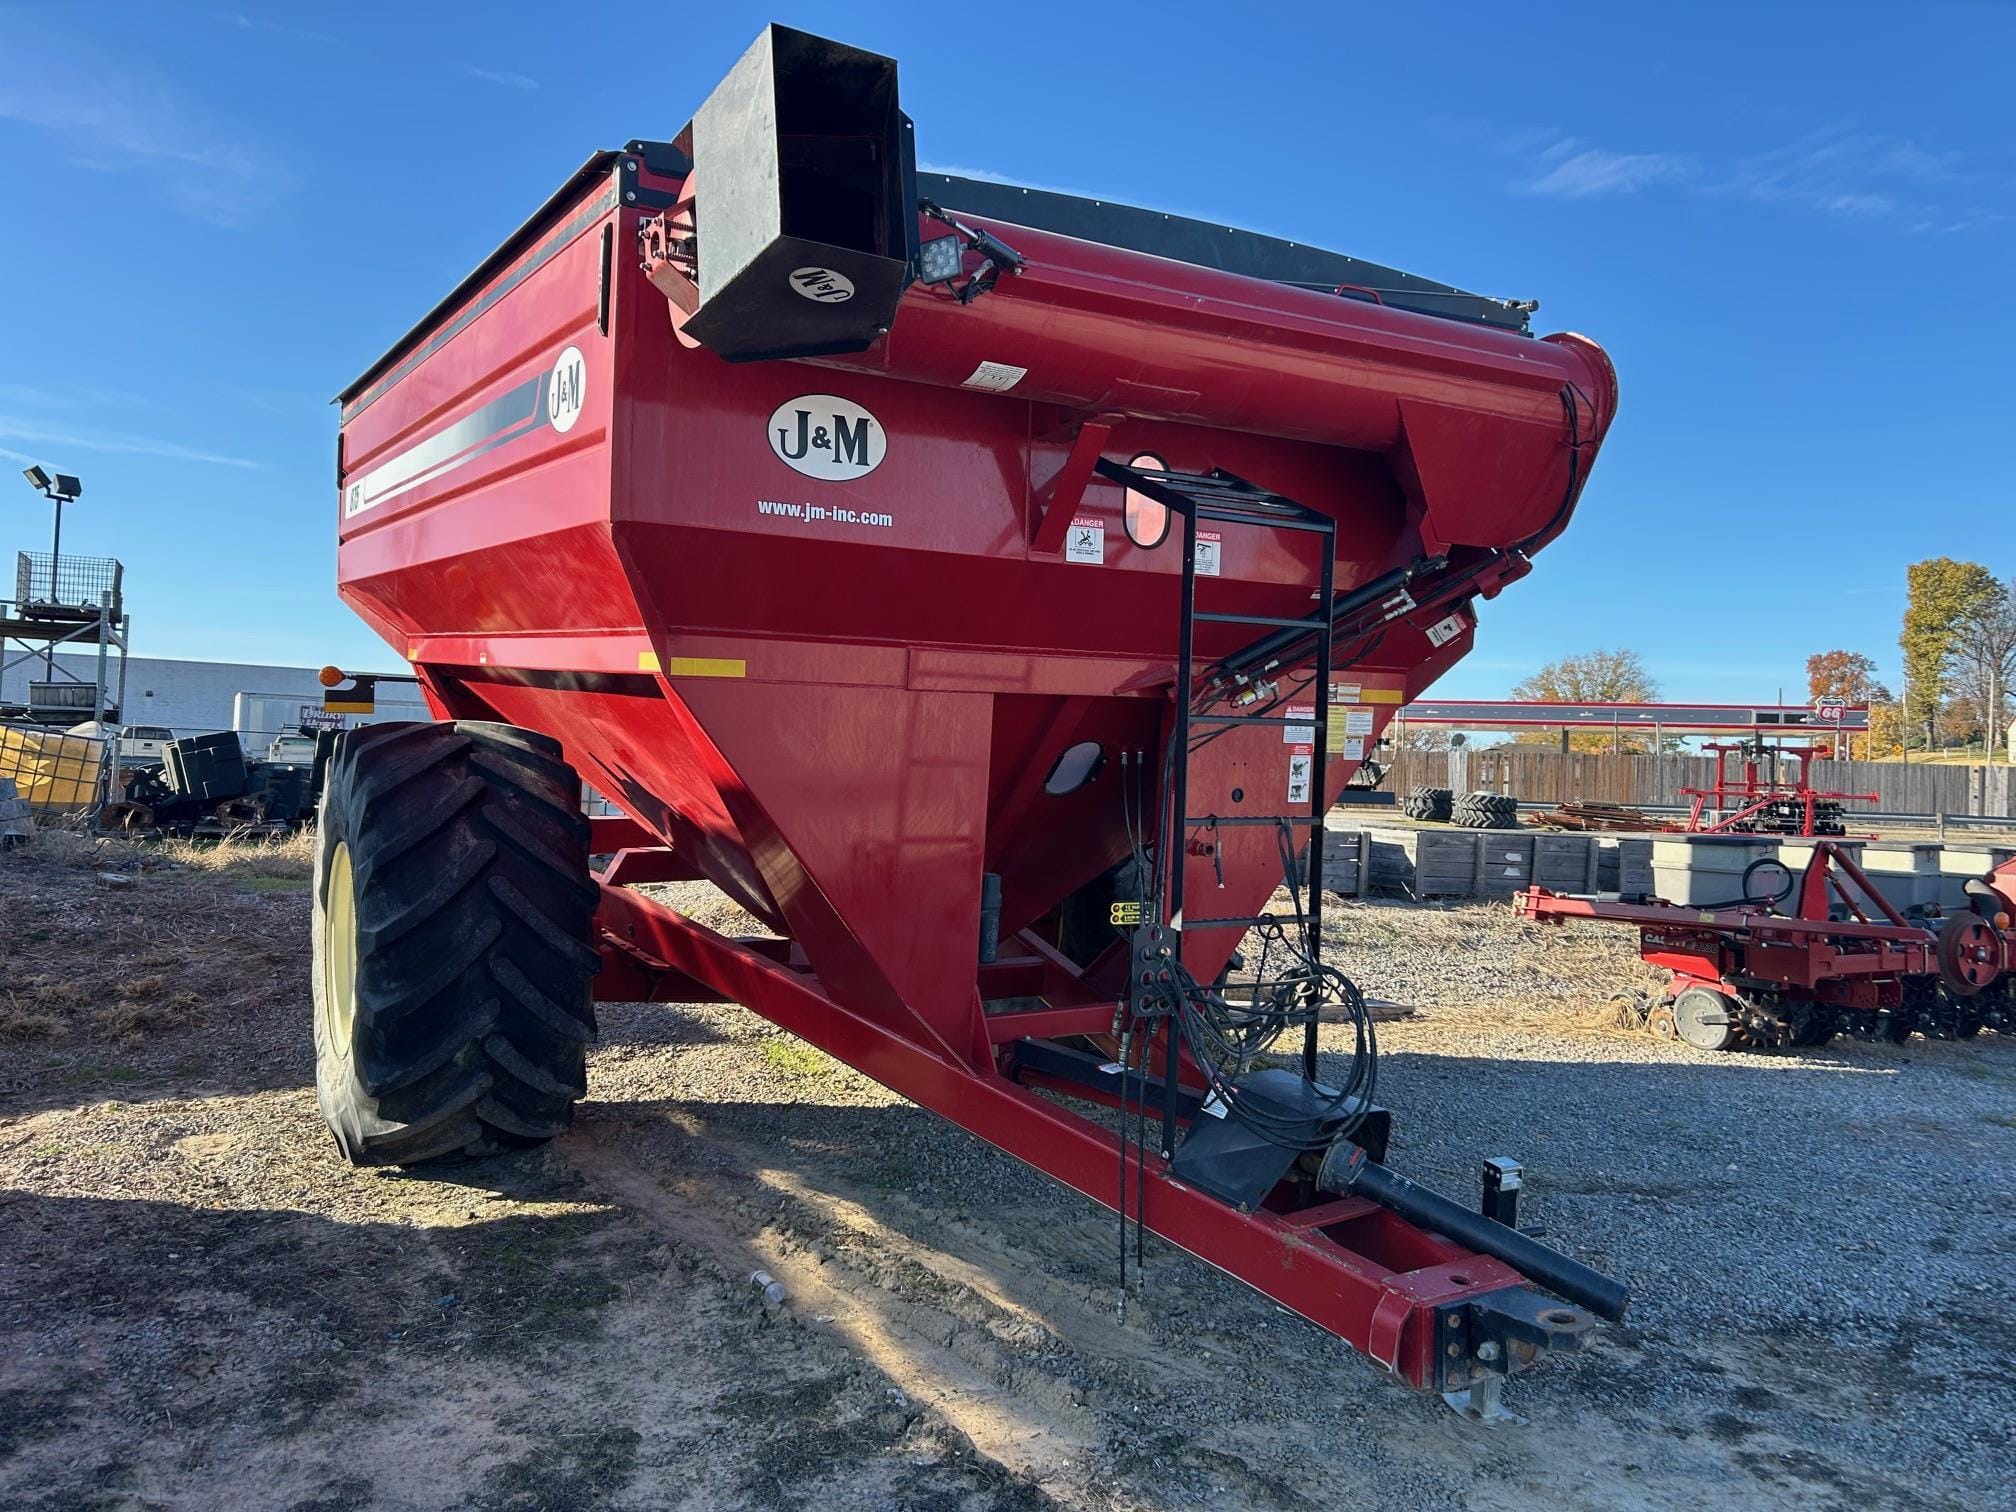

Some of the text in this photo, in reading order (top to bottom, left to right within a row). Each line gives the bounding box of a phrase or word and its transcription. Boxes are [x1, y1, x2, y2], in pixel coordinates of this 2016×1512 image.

[792, 269, 850, 300] J&M
[551, 360, 581, 419] J&M
[777, 409, 871, 467] J&M
[757, 500, 893, 527] www.jm-inc.com
[1074, 518, 1104, 528] DANGER
[1822, 707, 1842, 719] 66
